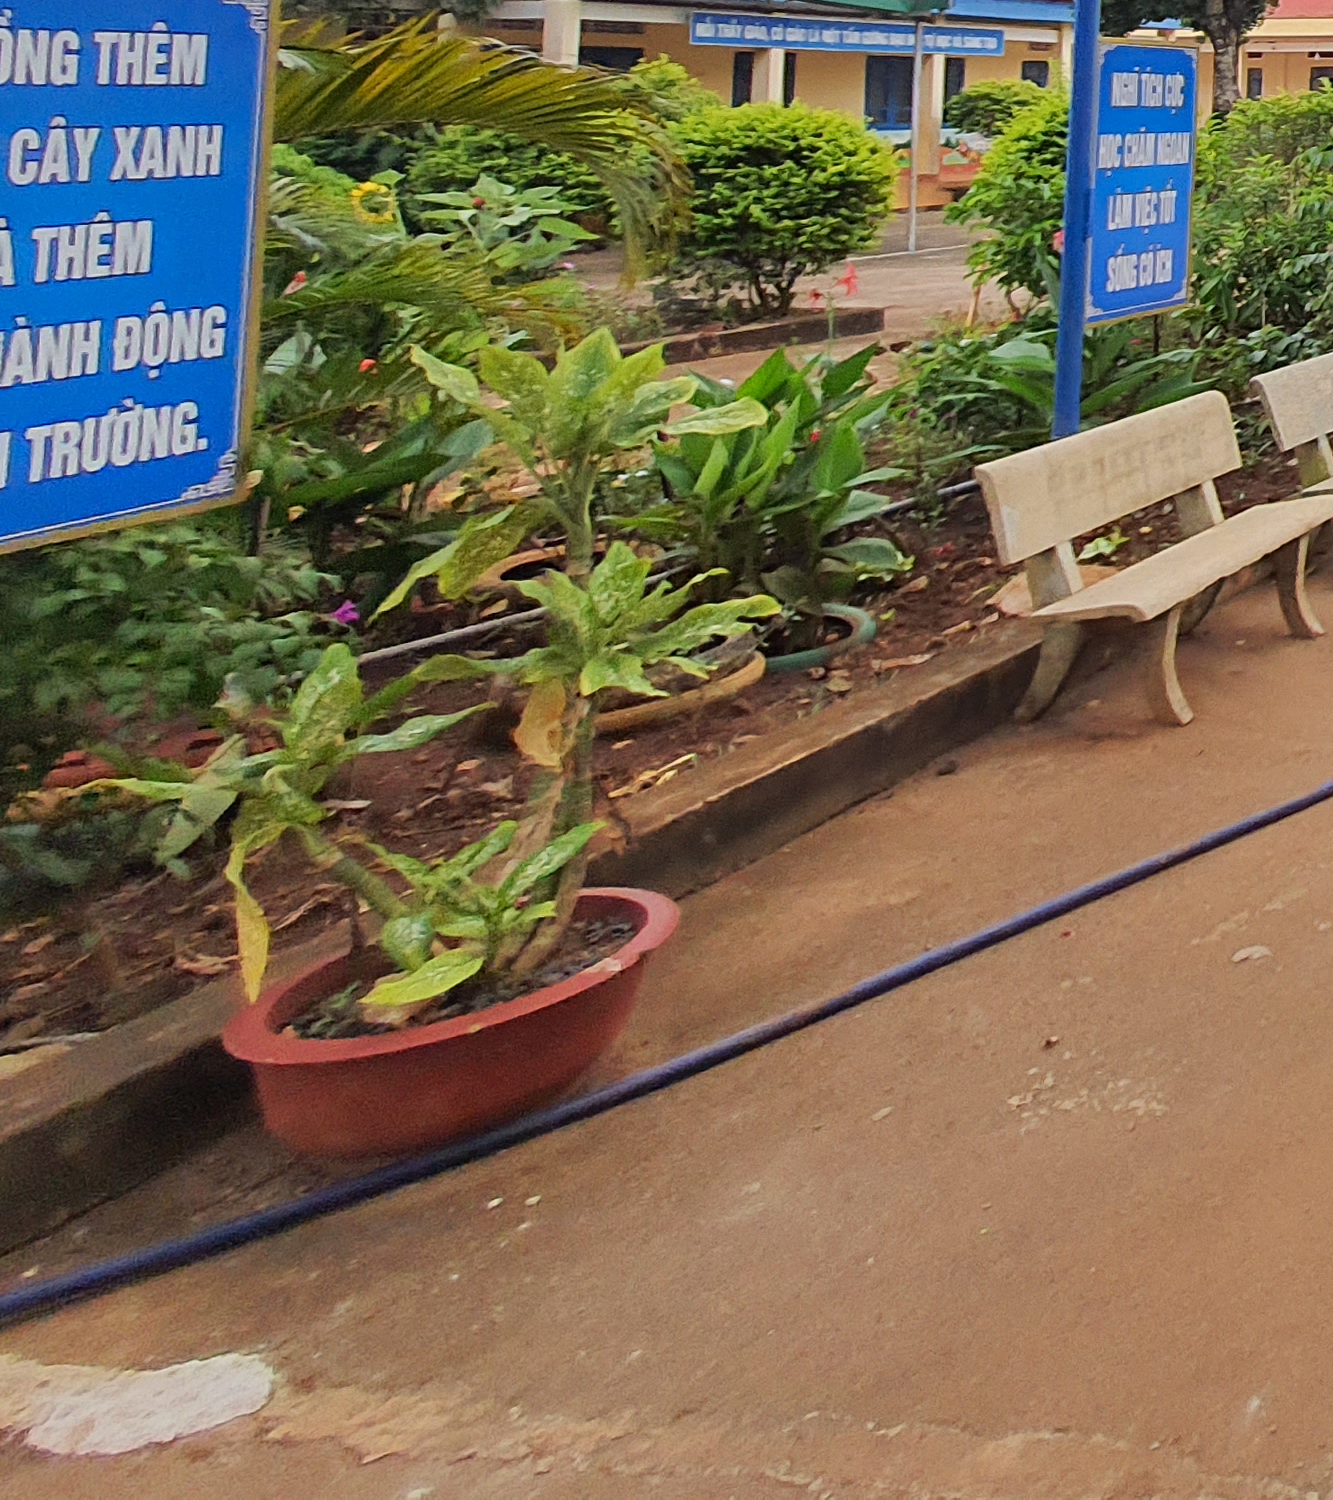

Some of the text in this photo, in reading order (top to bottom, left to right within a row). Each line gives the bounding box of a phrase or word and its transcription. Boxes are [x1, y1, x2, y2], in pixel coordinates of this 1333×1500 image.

[93, 20, 209, 86] THÊM
[8, 116, 224, 187] CÂY XANH
[32, 211, 153, 284] THÊM
[0, 300, 227, 388] ÀNH ĐỘNG
[25, 397, 208, 484] TRƯỜNG.
